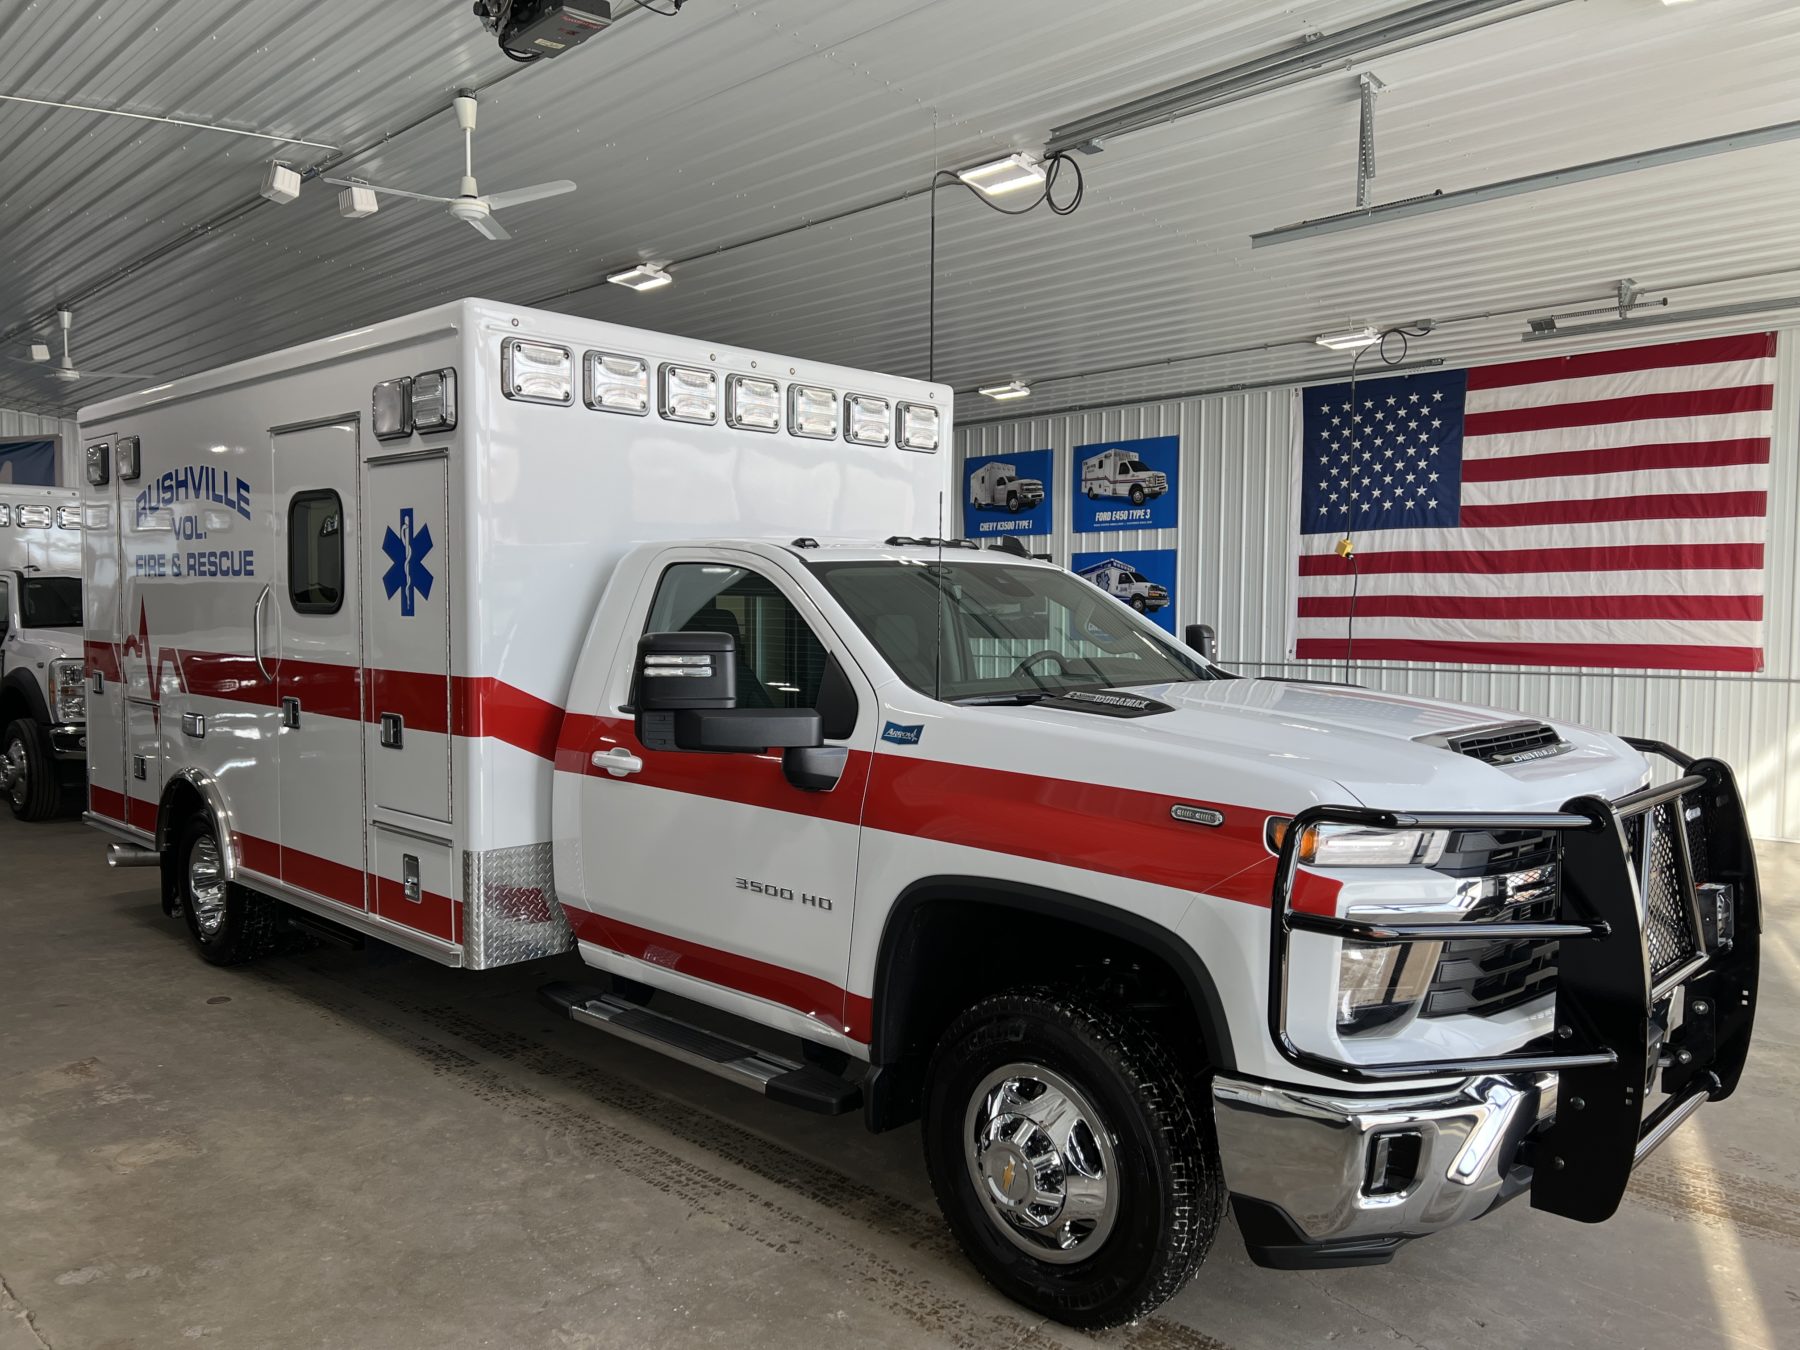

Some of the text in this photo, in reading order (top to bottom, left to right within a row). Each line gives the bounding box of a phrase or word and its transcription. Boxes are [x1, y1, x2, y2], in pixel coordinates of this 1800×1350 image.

[136, 465, 251, 528] RUSHVILLE
[172, 515, 207, 541] VOL.
[979, 522, 997, 532] CHEVY
[1015, 520, 1029, 530] TYPE
[1095, 508, 1151, 522] FORD E450 TYPE 3
[136, 550, 255, 577] FIRE & RESCUE
[1096, 694, 1149, 709] DURAMAX
[736, 877, 833, 911] 3500 HD
